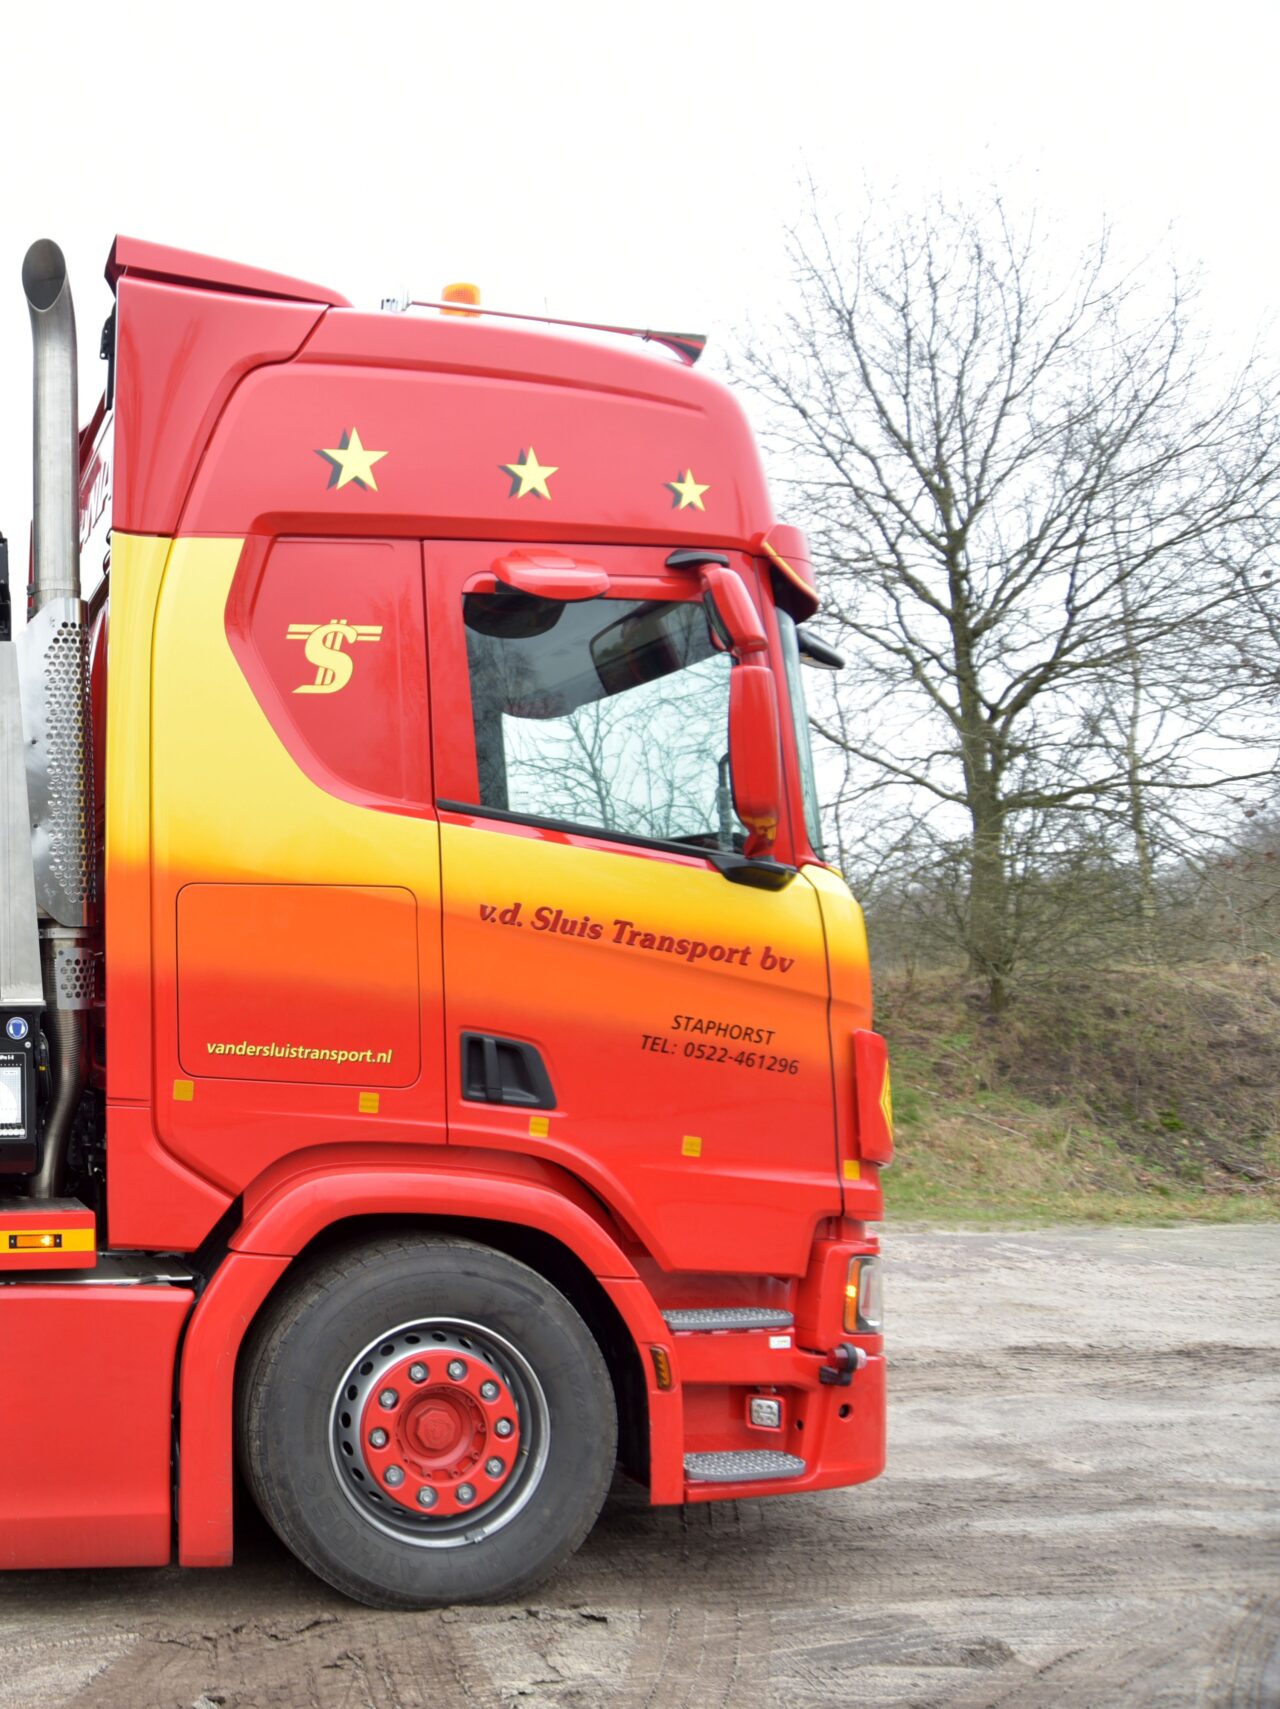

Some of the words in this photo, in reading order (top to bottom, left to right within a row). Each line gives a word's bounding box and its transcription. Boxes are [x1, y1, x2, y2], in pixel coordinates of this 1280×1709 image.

[478, 902, 523, 928] v.d.
[530, 906, 604, 940] Sluis
[612, 919, 752, 967] Transport
[759, 946, 795, 973] bv
[671, 1014, 776, 1045] STAPHORST
[206, 1041, 393, 1064] vandersluistransport.nl
[640, 1034, 678, 1055] TEL:
[683, 1041, 800, 1075] 0522-461296
